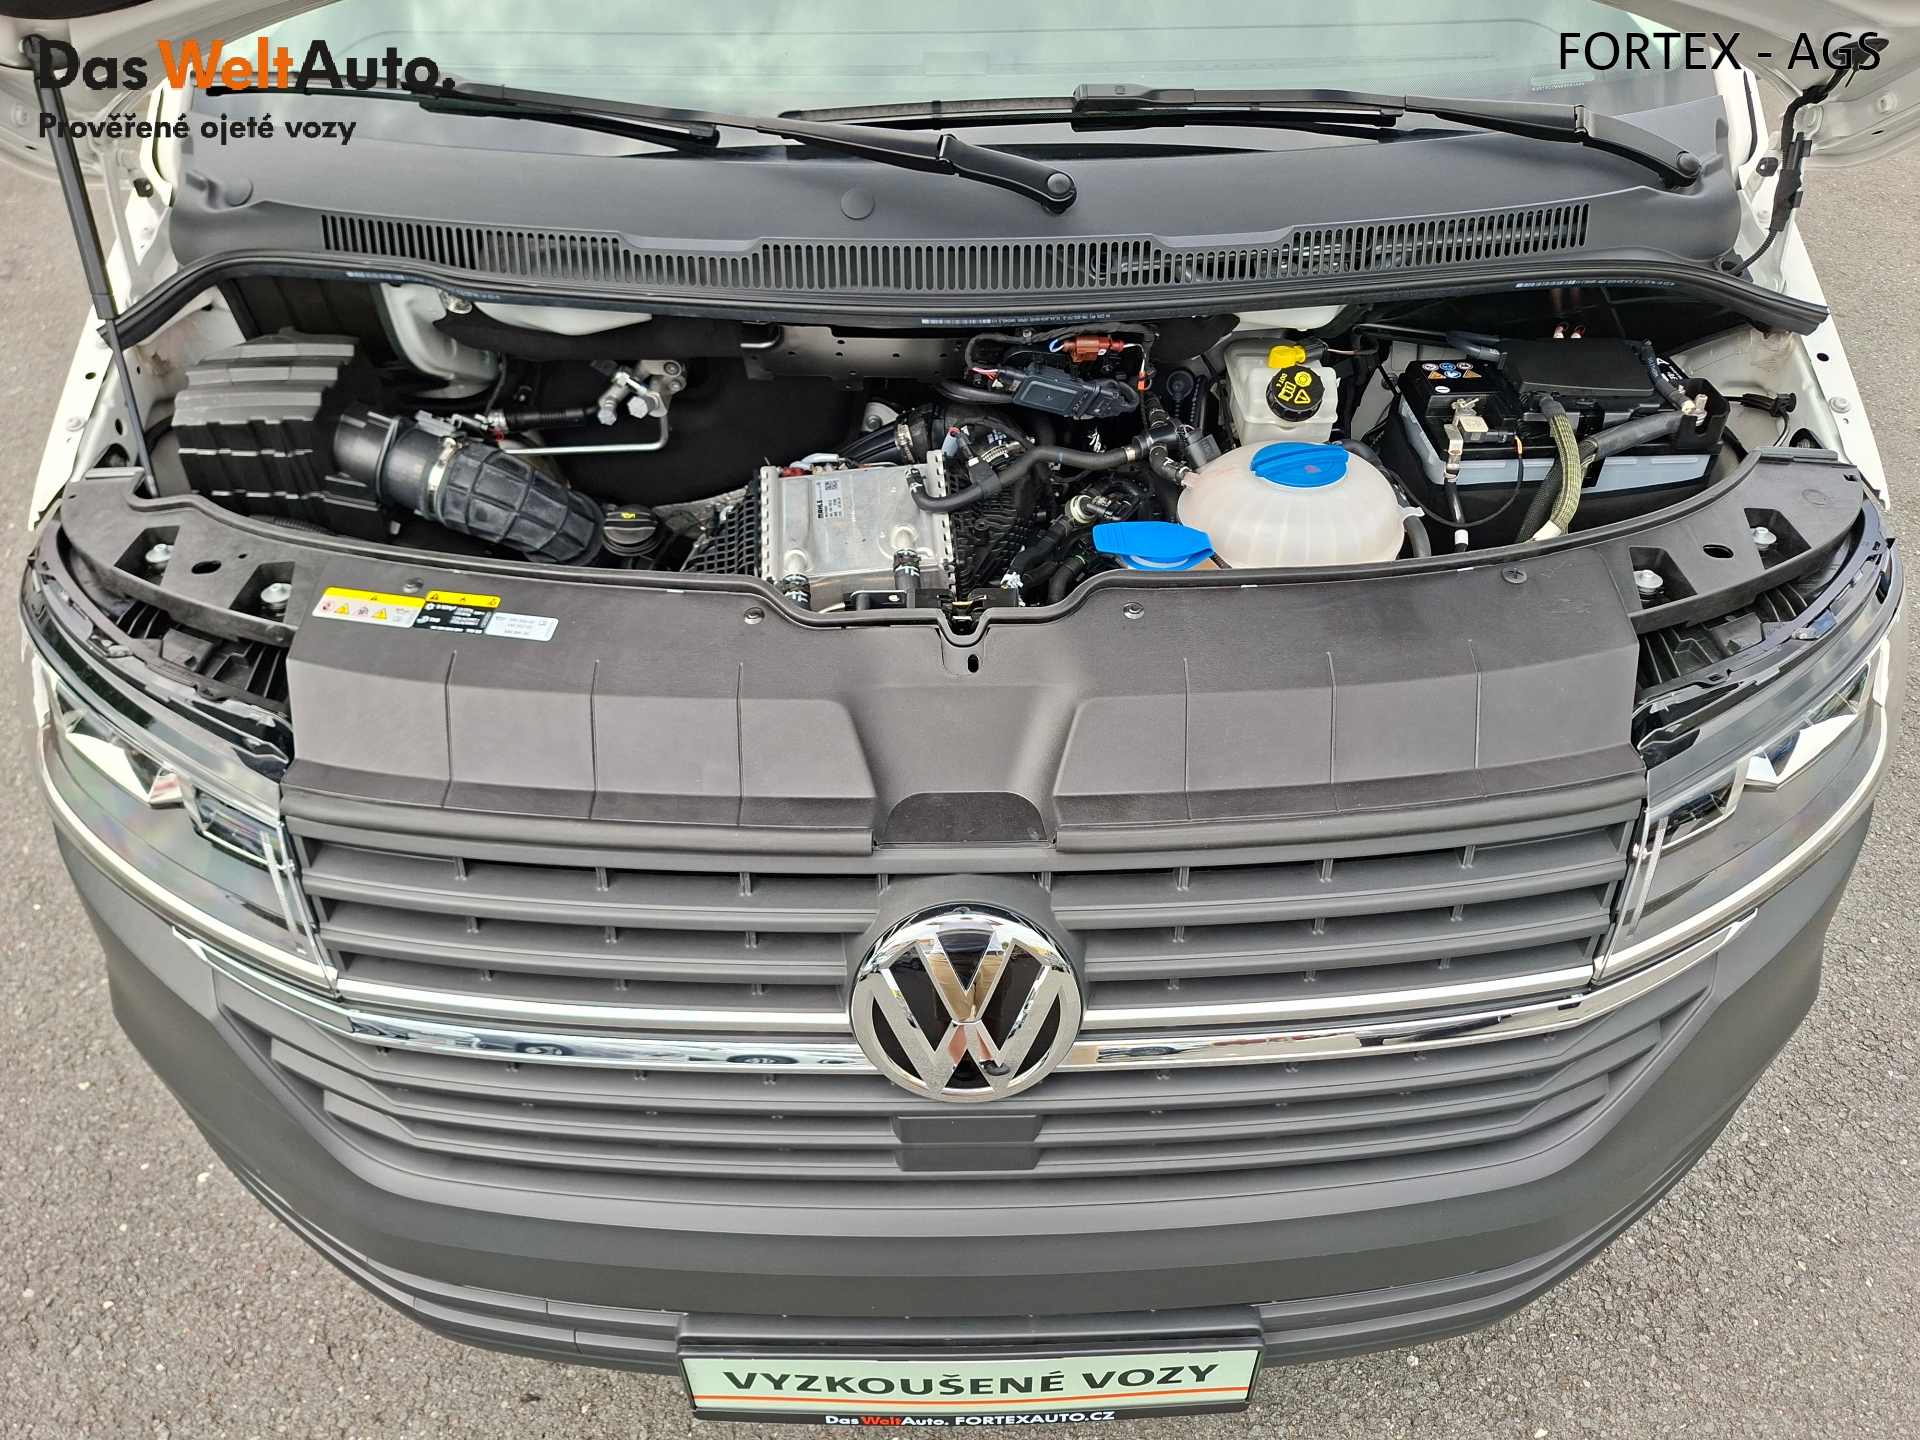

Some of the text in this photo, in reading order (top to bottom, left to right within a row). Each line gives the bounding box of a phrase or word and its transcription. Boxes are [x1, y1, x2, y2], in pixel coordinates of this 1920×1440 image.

[722, 1363, 1220, 1398] VYZKOUŠENÉ VOZY
[825, 1414, 860, 1426] Das
[955, 1410, 1115, 1427] FORTEXAUTO.CZ
